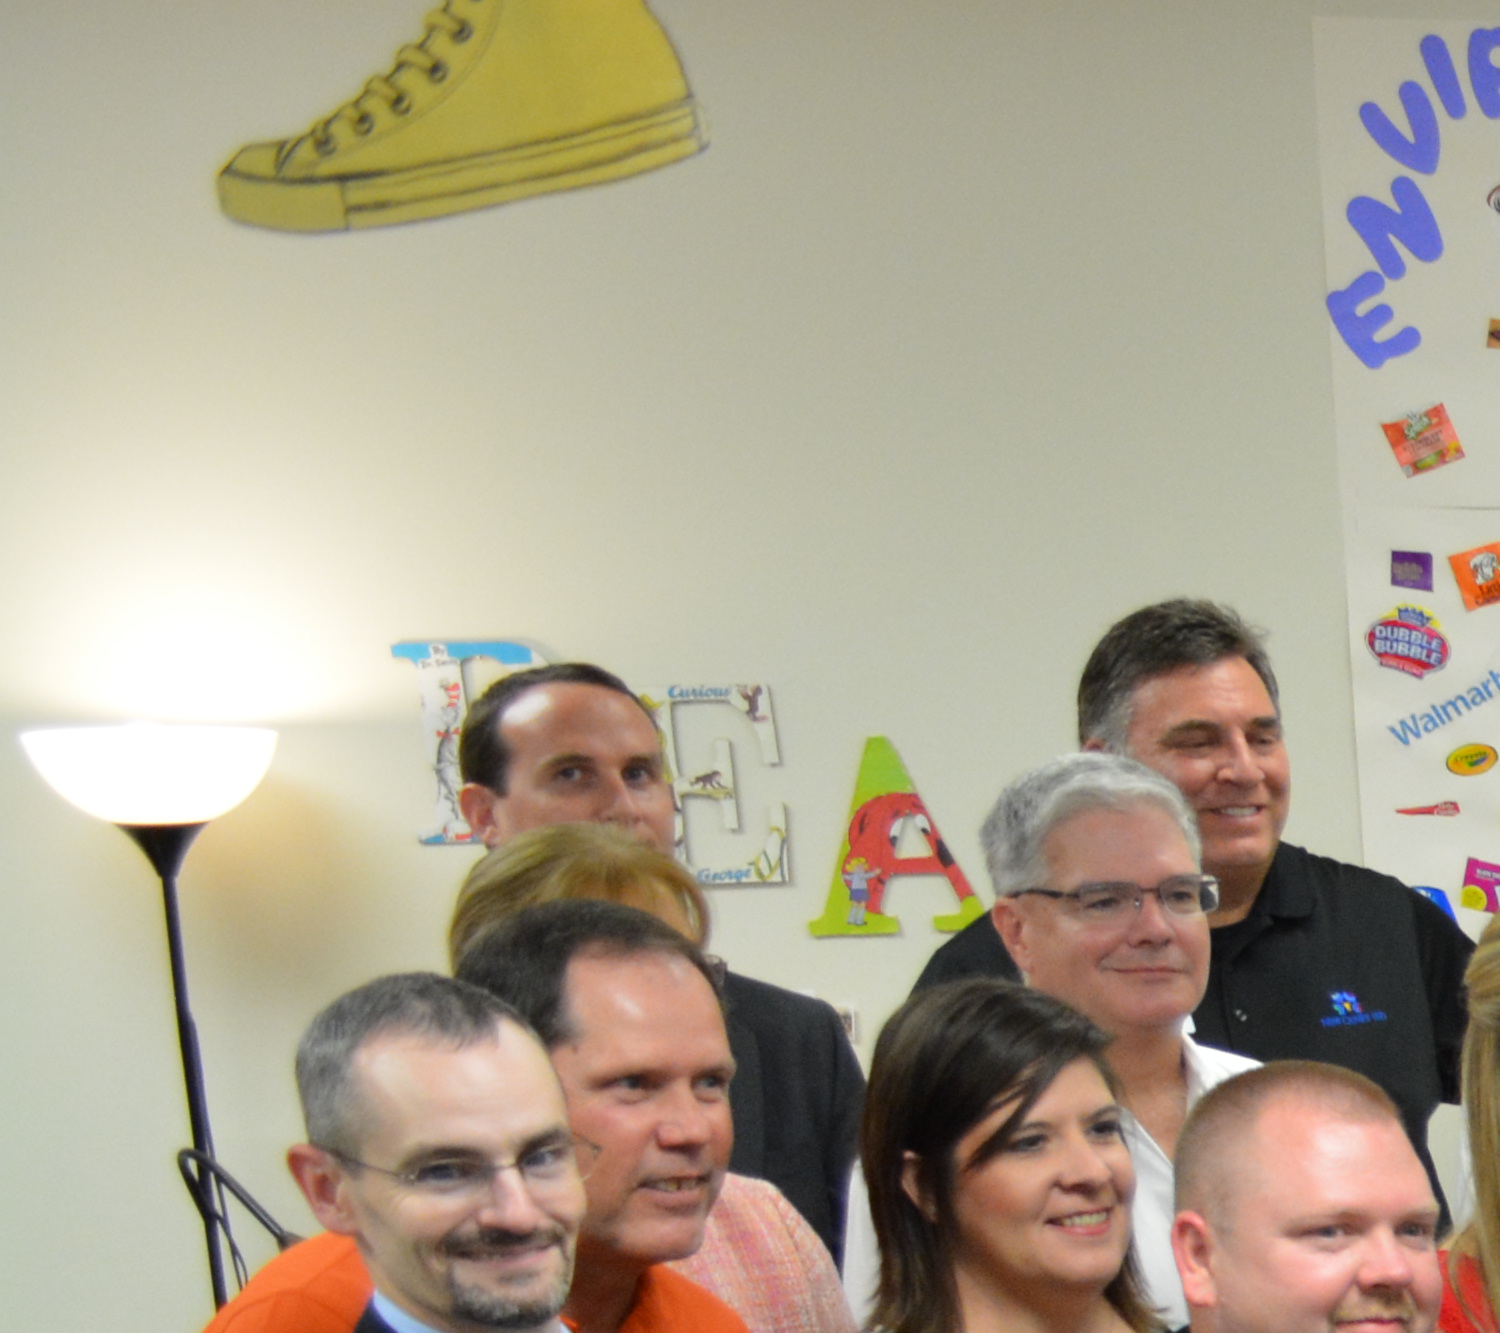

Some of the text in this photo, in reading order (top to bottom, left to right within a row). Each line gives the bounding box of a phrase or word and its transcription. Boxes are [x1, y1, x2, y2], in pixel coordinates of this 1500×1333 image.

[1374, 625, 1442, 651] DUBBLE
[1374, 639, 1442, 667] BUBBLE
[668, 684, 732, 699] Curious
[697, 868, 752, 883] George
